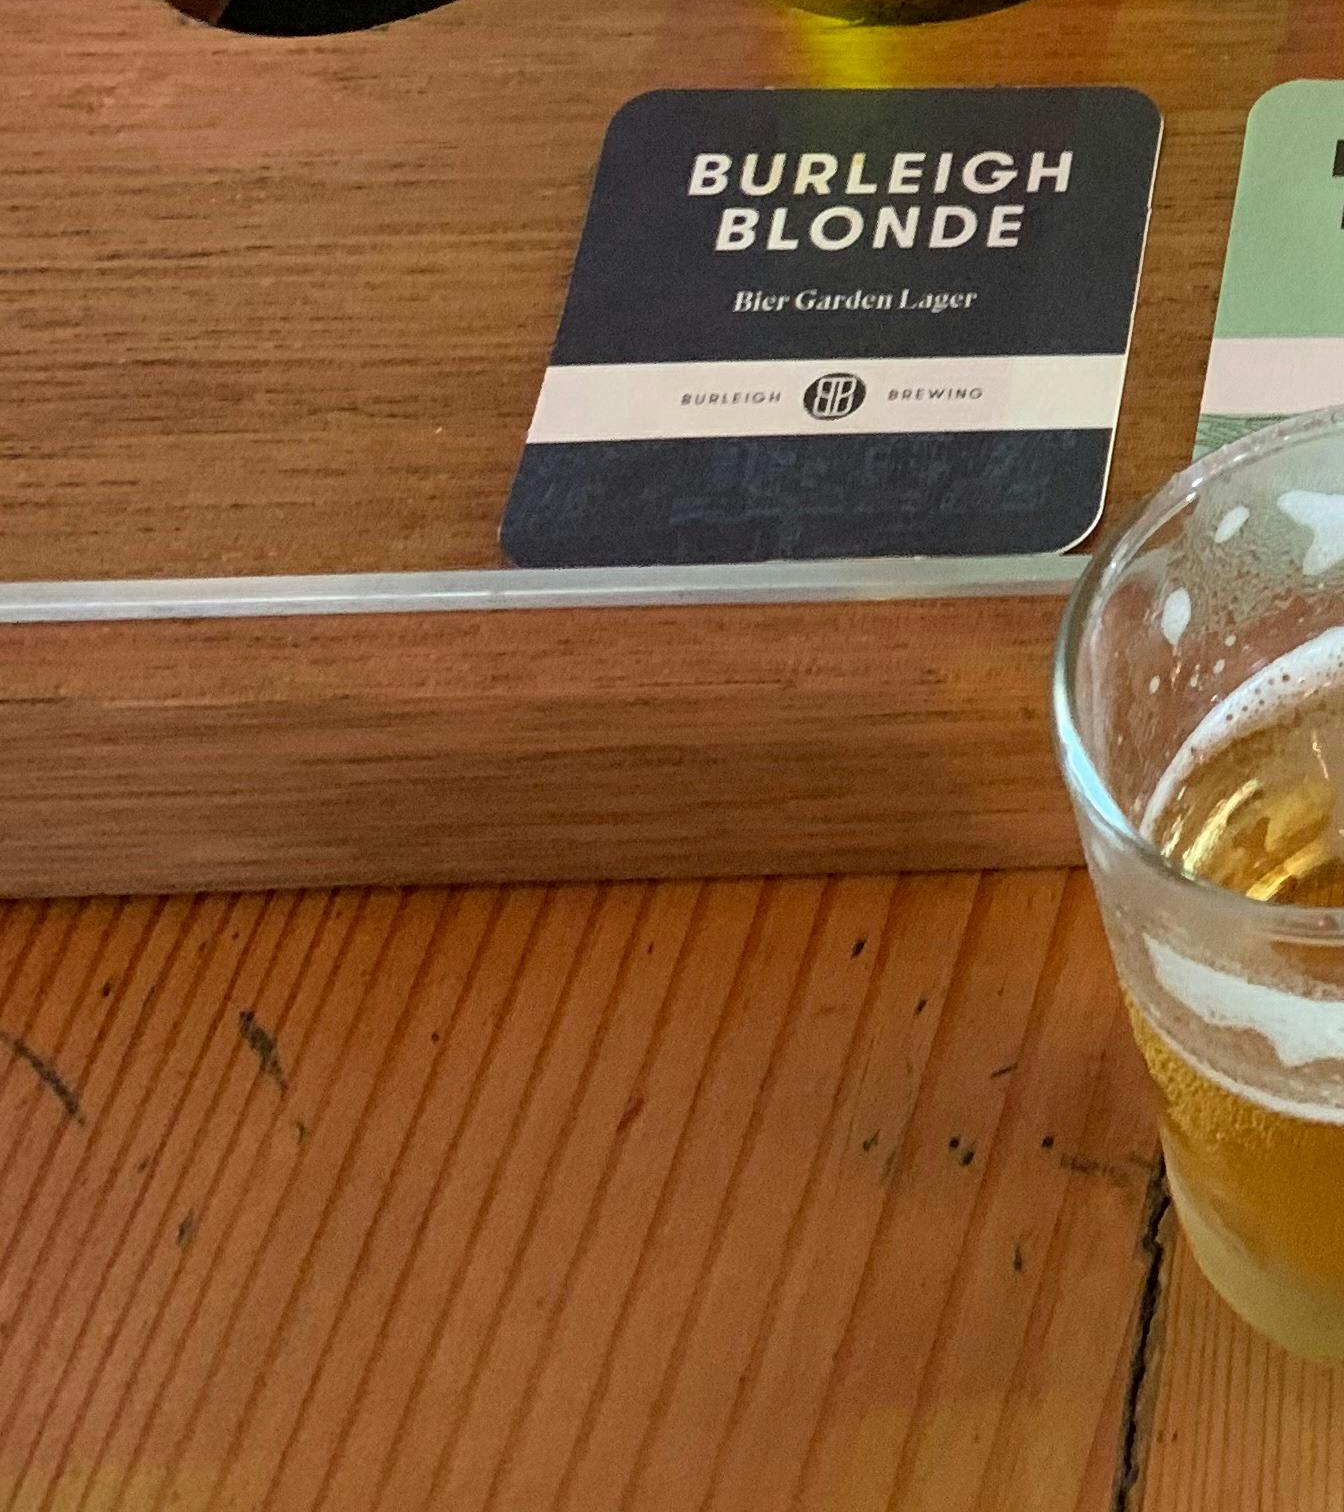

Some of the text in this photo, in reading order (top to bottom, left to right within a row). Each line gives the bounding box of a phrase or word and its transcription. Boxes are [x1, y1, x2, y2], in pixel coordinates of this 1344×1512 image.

[688, 150, 1074, 197] BURLEIGH
[714, 204, 1025, 252] BLONDE
[732, 288, 979, 315] Bier Garden Lager
[680, 391, 782, 407] BURLEIGH
[887, 388, 984, 402] BREWING
